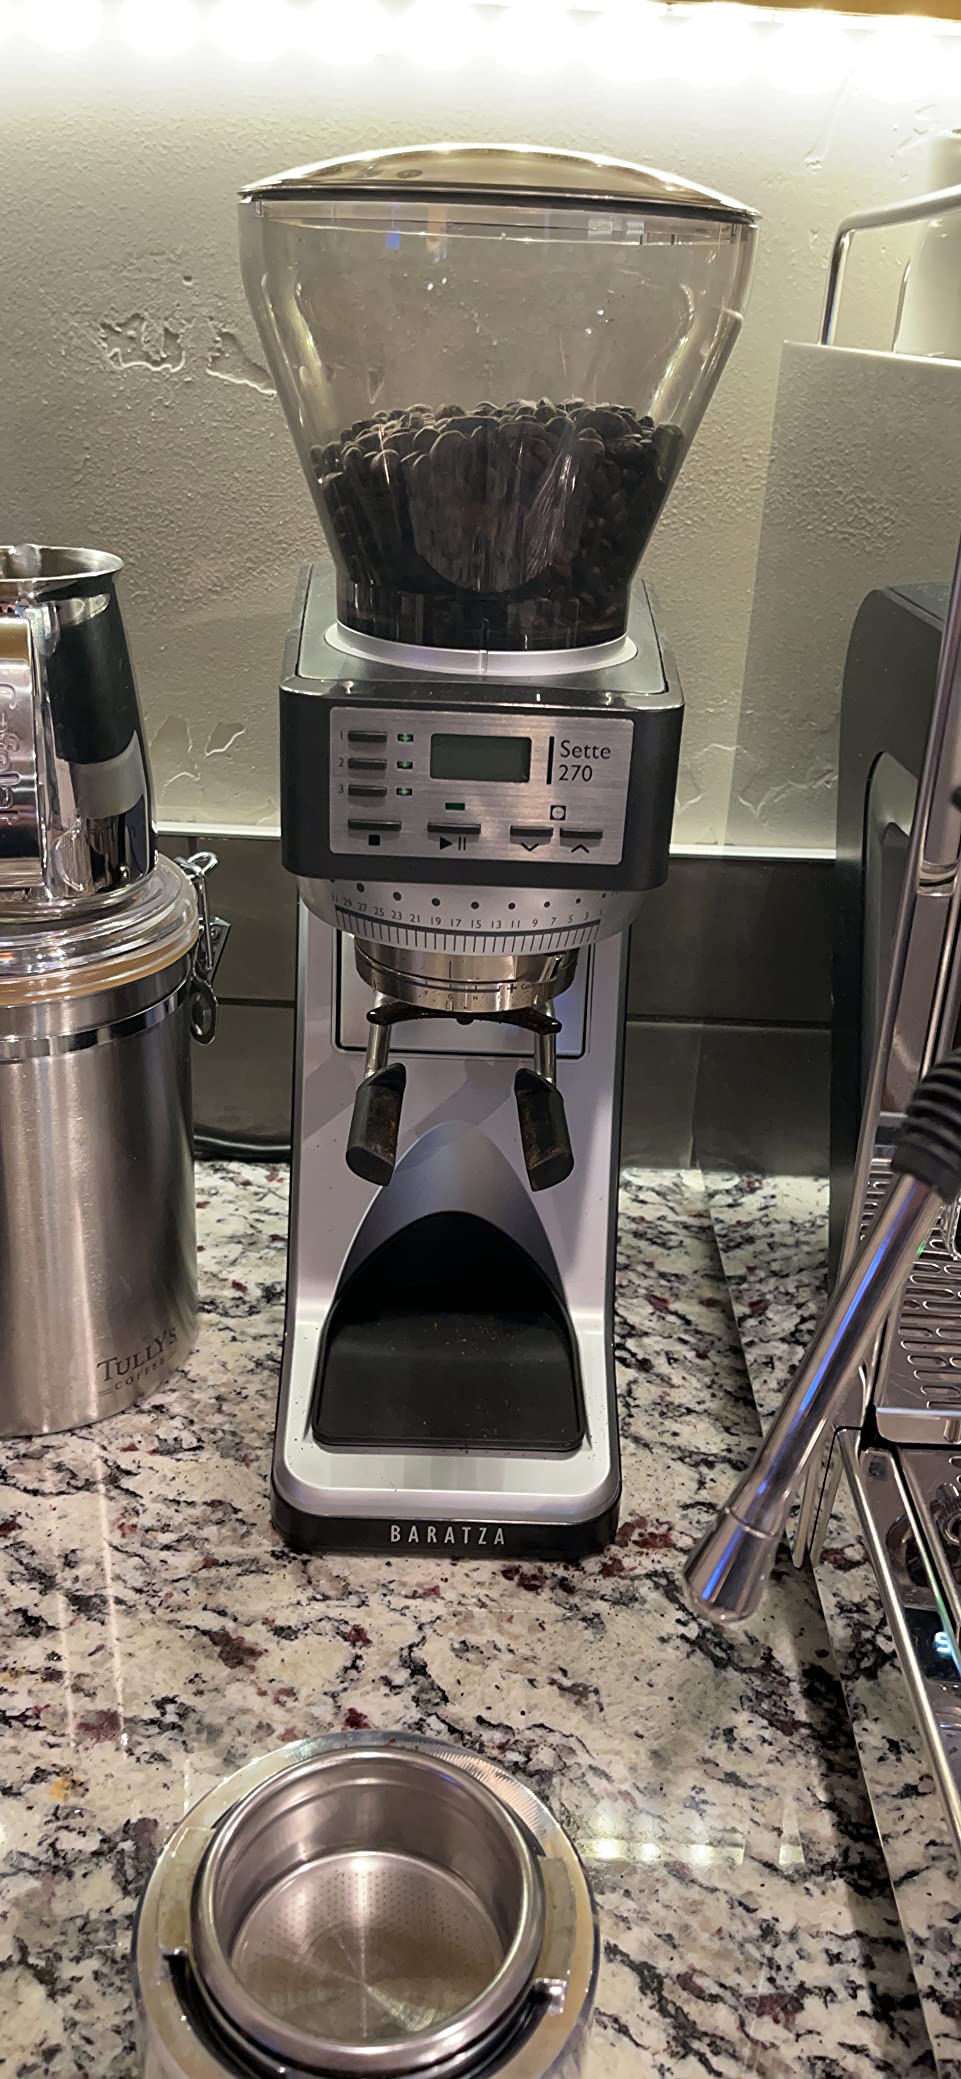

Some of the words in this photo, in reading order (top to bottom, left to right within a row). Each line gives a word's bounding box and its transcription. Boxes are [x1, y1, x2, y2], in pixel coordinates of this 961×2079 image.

[559, 740, 612, 760] Sette
[338, 756, 345, 768] 2
[557, 764, 593, 782] 270
[338, 783, 345, 794] 3
[373, 906, 385, 917] 25
[391, 910, 402, 921] 23
[409, 913, 420, 923] 21
[430, 916, 442, 926] 19
[450, 918, 462, 928] 17
[470, 919, 482, 929] 15
[491, 920, 502, 930] 13
[511, 919, 521, 929] 11
[532, 918, 538, 928] 9
[551, 916, 557, 927] 7
[568, 914, 574, 924] 5
[390, 1525, 505, 1545] BARATZA
